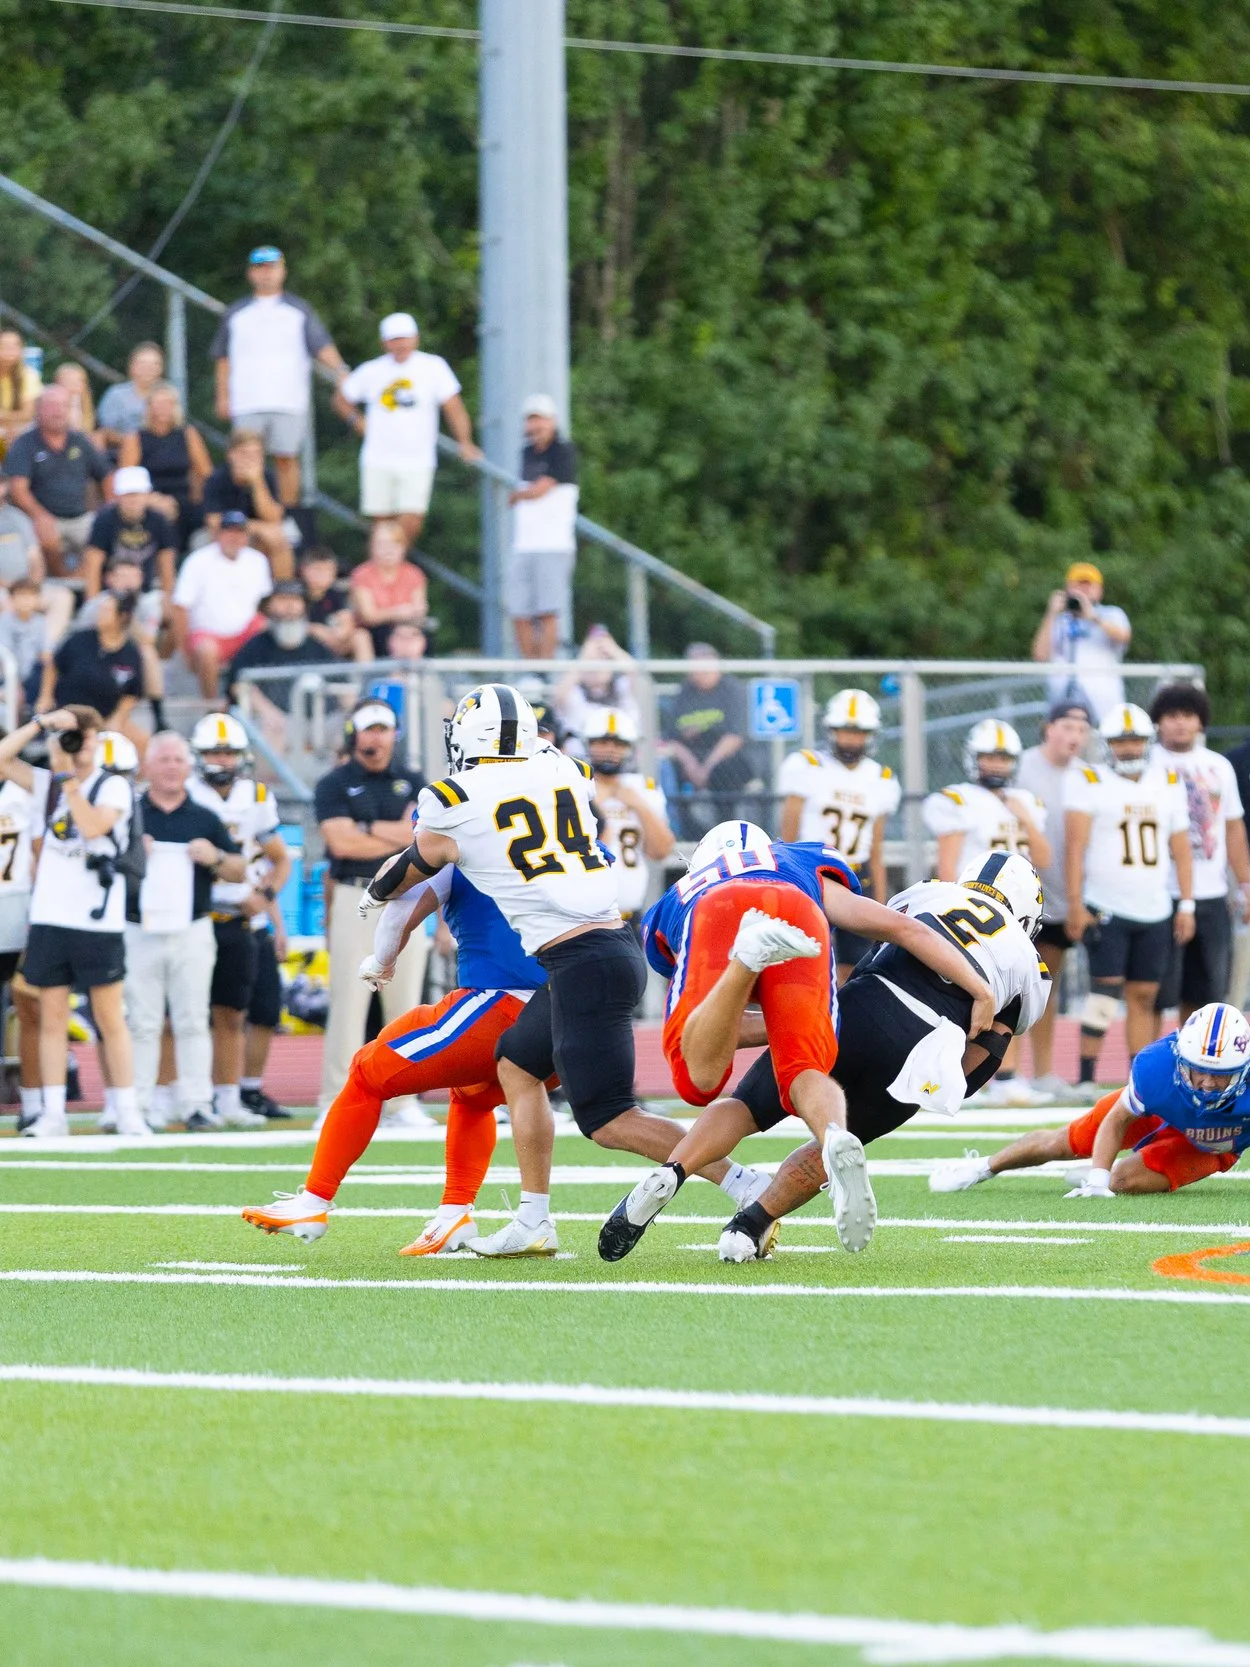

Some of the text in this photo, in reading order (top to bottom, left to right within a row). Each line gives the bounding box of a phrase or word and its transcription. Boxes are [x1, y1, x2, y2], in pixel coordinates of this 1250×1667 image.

[493, 785, 607, 882] 24
[822, 806, 869, 856] 37
[1118, 820, 1158, 866] 10
[935, 896, 1008, 949] 2
[1185, 1126, 1243, 1142] BRUINS
